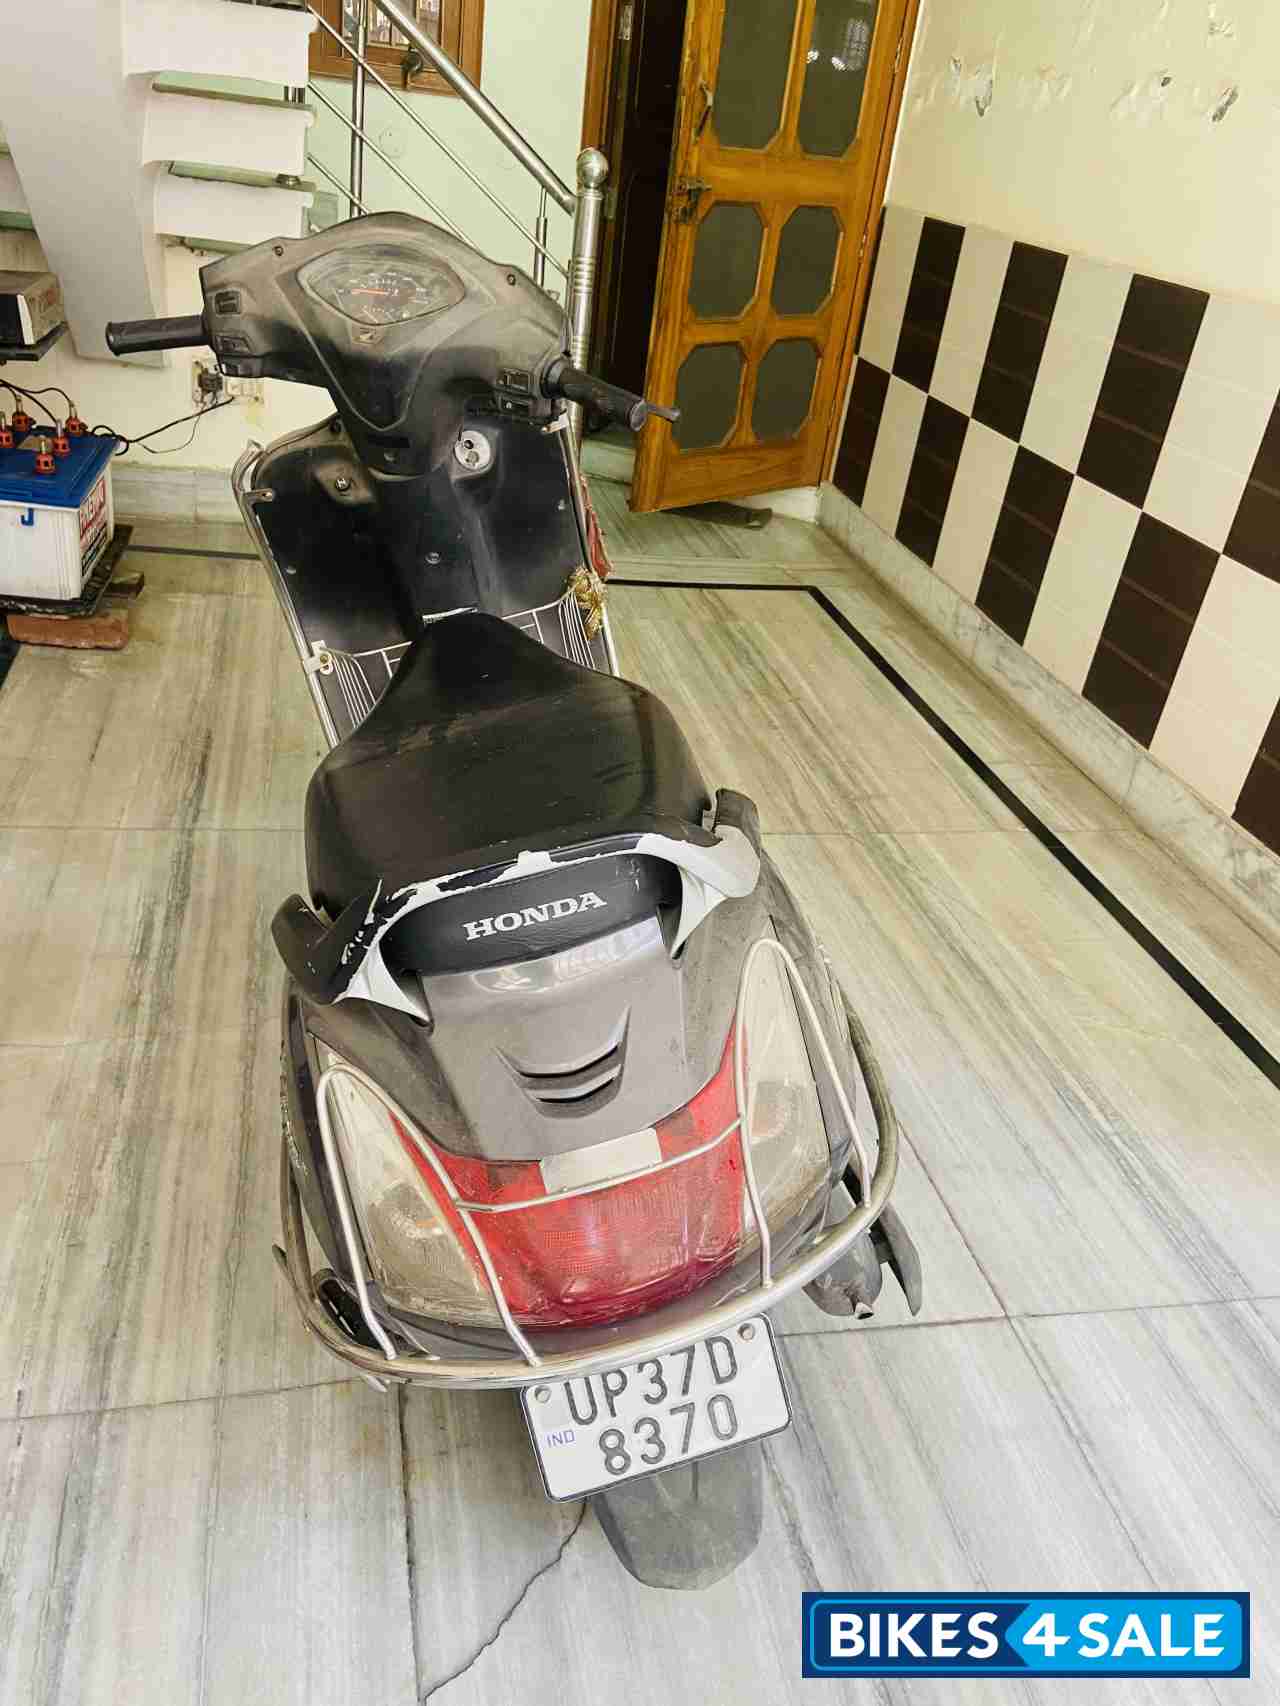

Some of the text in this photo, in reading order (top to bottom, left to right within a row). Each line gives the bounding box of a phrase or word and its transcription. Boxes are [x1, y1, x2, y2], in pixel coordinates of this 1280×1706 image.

[462, 891, 608, 941] HONDA
[546, 1429, 576, 1447] IND
[599, 1393, 738, 1475] 8370
